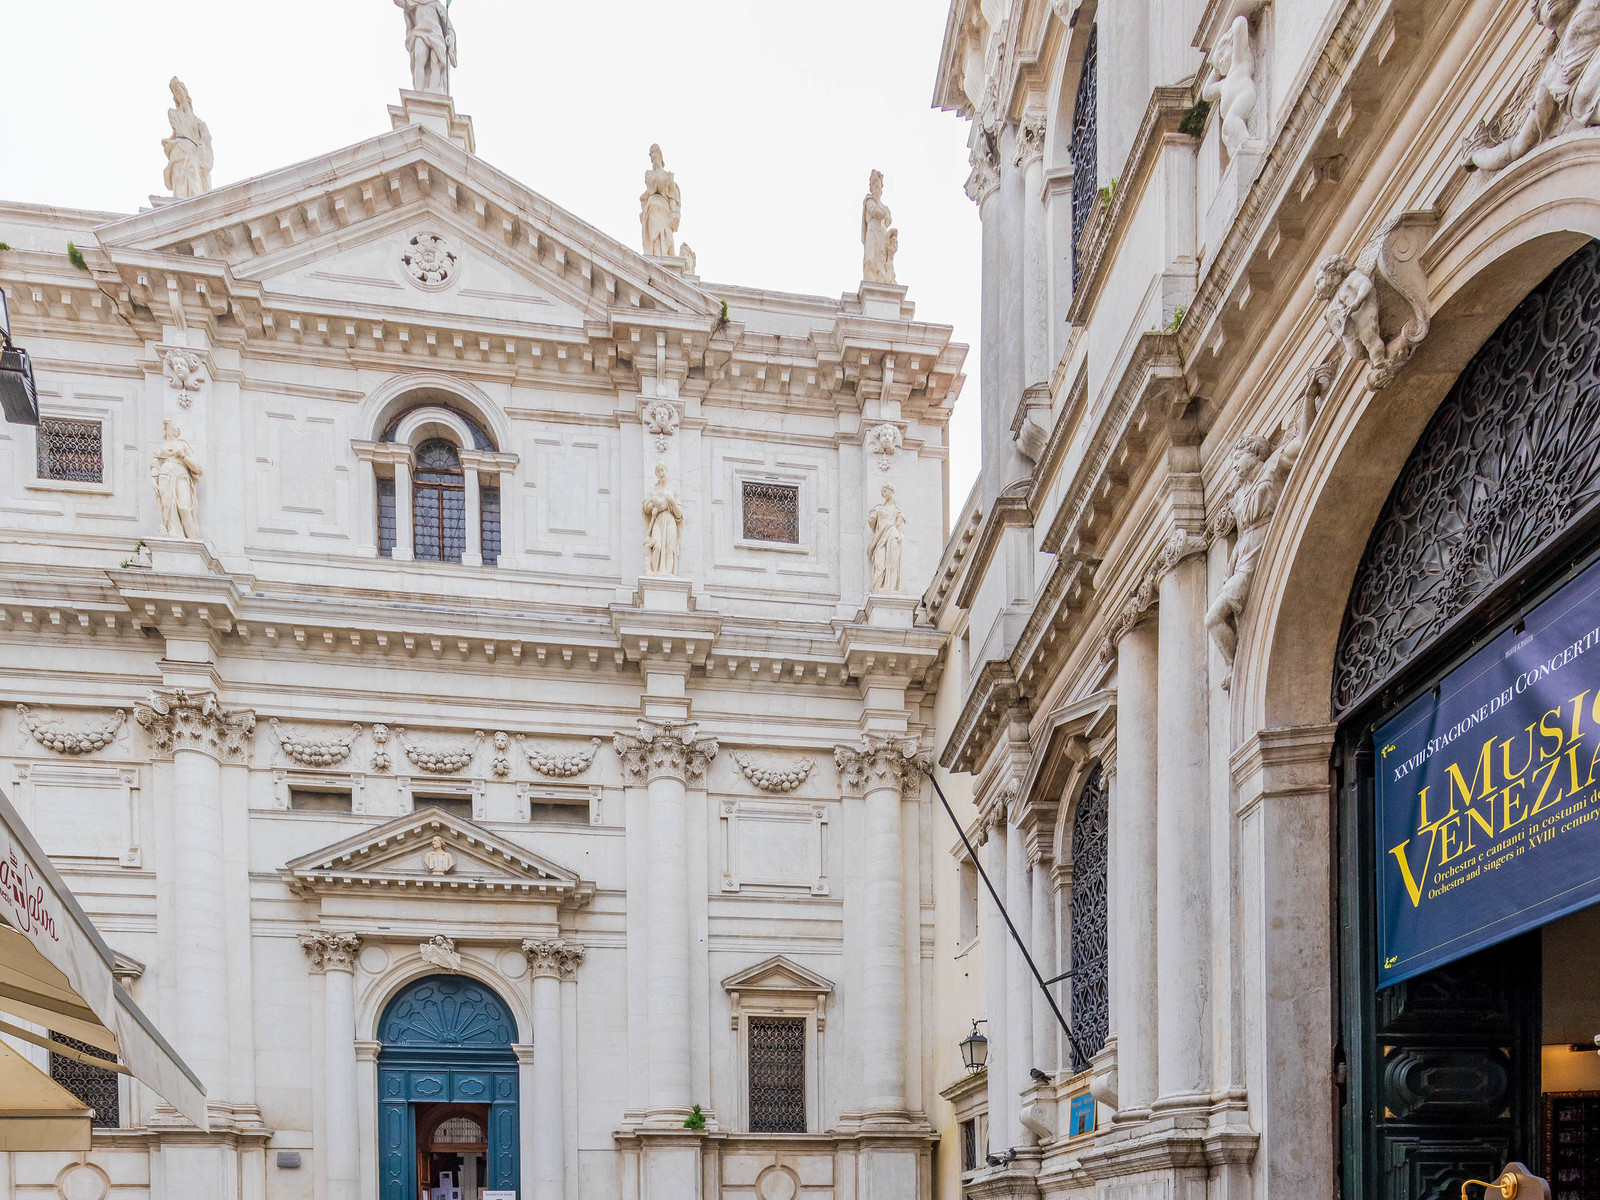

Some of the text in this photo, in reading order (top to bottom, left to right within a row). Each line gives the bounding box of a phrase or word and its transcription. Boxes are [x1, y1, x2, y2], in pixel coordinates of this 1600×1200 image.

[1394, 748, 1427, 783] XXVIII
[1426, 703, 1489, 759] STAGIONE
[1490, 685, 1514, 718] DEI
[1515, 625, 1600, 694] CONCERTI
[1417, 786, 1432, 831] I
[1428, 807, 1600, 900] Orchestra and singers in XVIII century
[1433, 856, 1476, 884] Orchestra
[1486, 827, 1525, 858] cantanti
[1528, 823, 1540, 836] in
[1541, 795, 1587, 828] costumi
